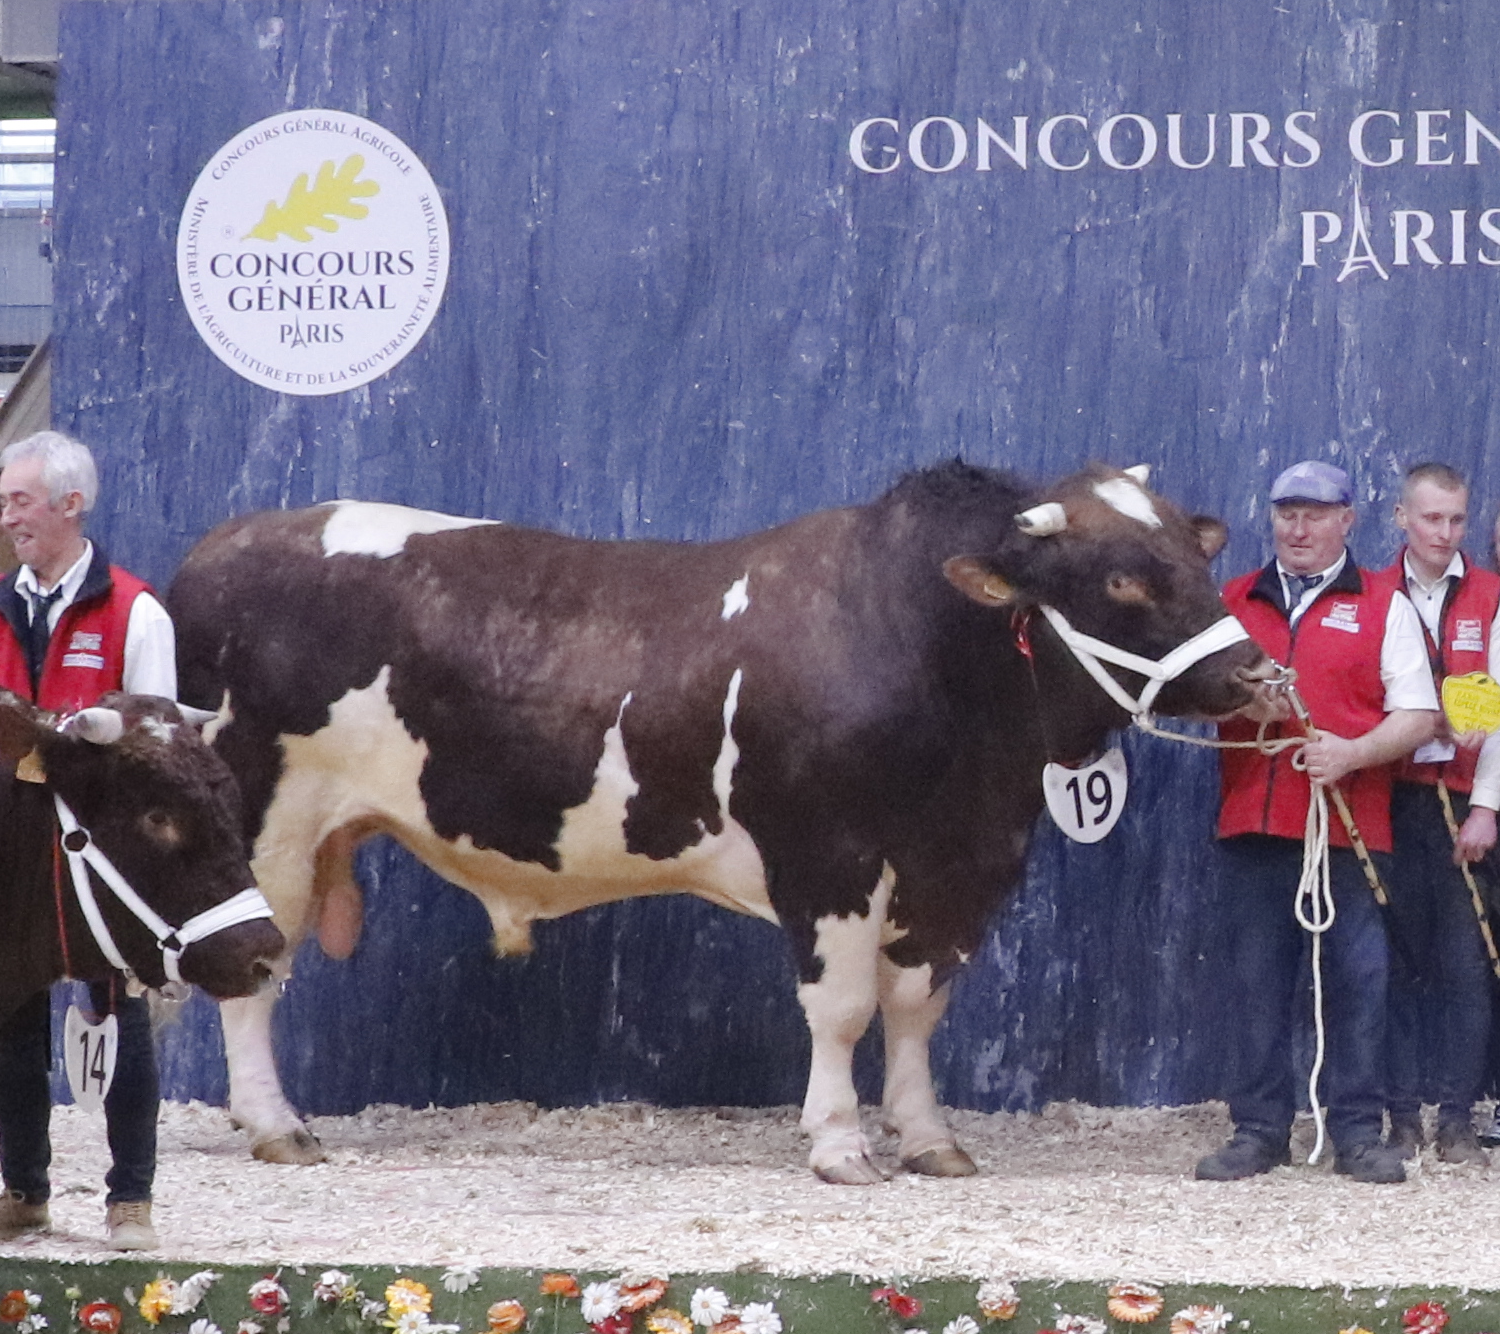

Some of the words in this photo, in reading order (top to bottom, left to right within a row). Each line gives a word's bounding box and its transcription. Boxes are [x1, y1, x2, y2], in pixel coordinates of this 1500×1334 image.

[211, 125, 281, 182] CONCOURS
[283, 117, 348, 136] GÉNÉRAL
[352, 125, 413, 177] AGRICOLE
[848, 110, 1322, 174] CONCOURS
[185, 196, 210, 279] MINISTÈRE
[210, 250, 415, 279] CONCOURS
[417, 192, 441, 289] ALIMENTAIRE
[189, 281, 205, 303] DE
[228, 279, 397, 312] GÉNÉRAL
[197, 301, 282, 382] L'AGRICULTURE
[279, 315, 345, 349] PARIS
[348, 293, 431, 378] SOUVERAINETÉ
[284, 372, 304, 385] ET
[306, 372, 327, 386] DE
[329, 369, 348, 384] LA
[1065, 768, 1113, 830] 19
[79, 1030, 107, 1095] 14
